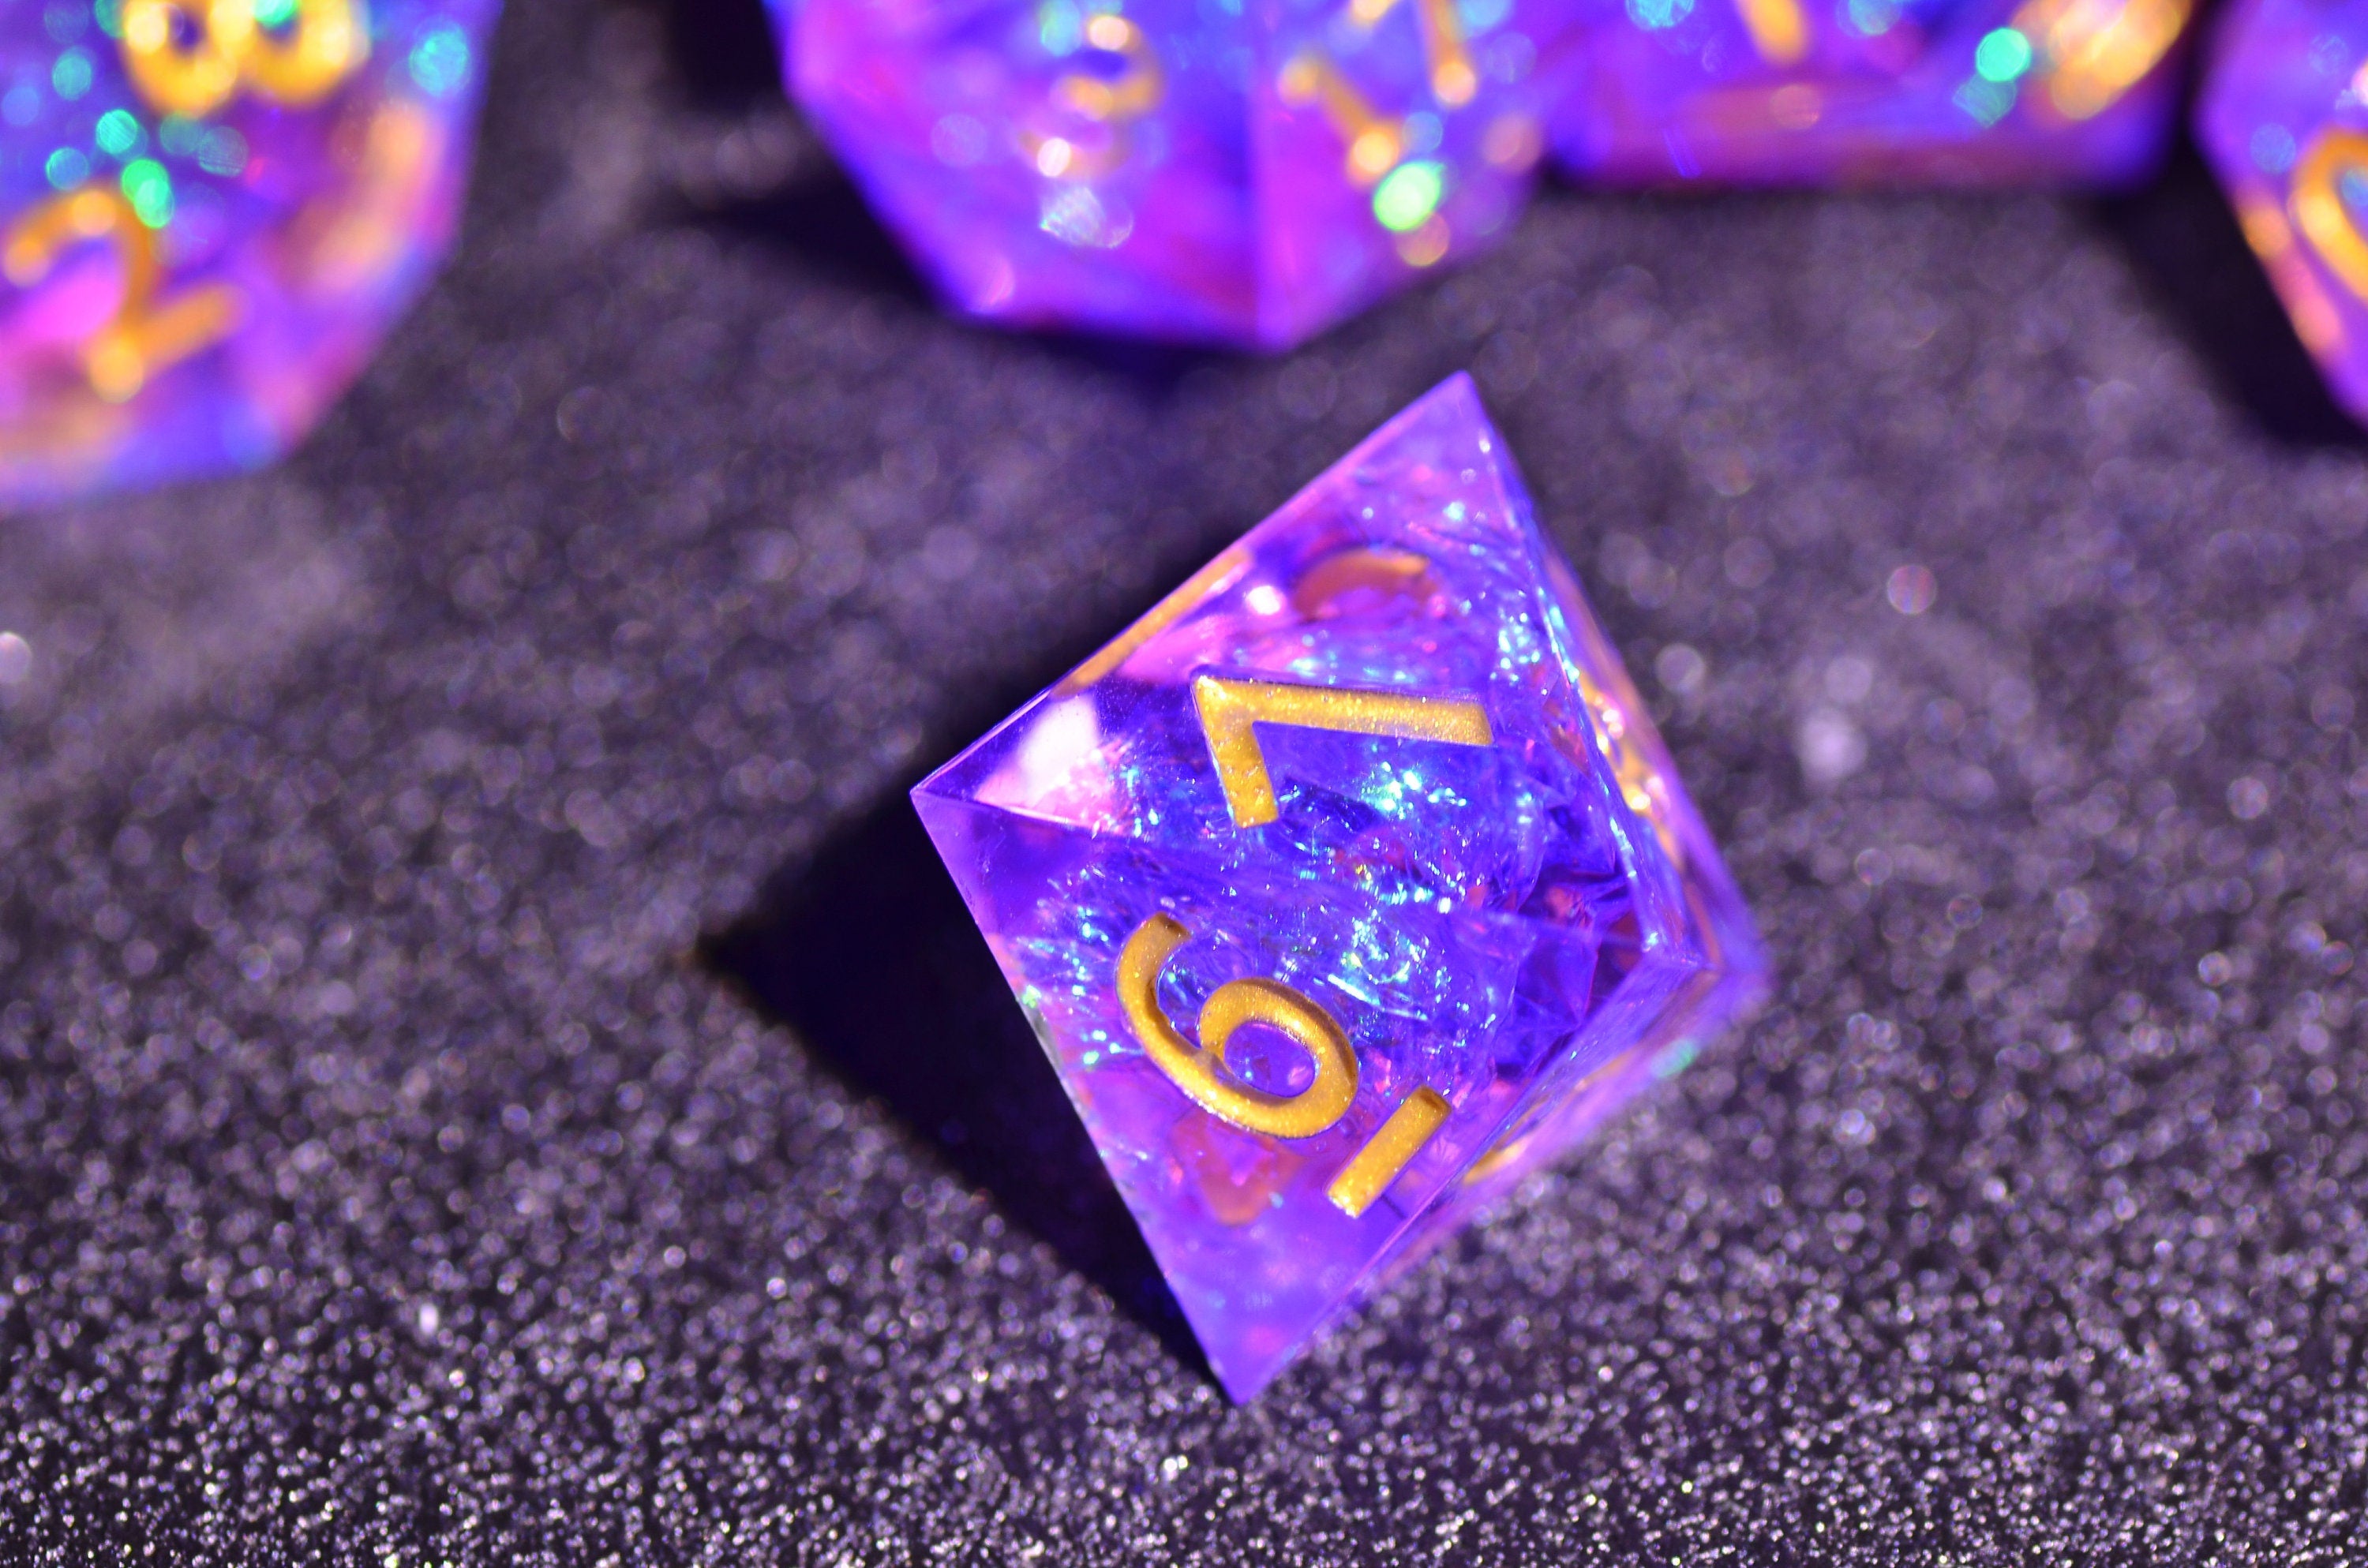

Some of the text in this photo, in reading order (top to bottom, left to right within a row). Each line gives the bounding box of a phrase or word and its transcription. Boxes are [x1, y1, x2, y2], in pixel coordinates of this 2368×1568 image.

[2, 183, 246, 402] 2
[1192, 675, 1493, 827] 7
[1117, 912, 1358, 1139] 6
